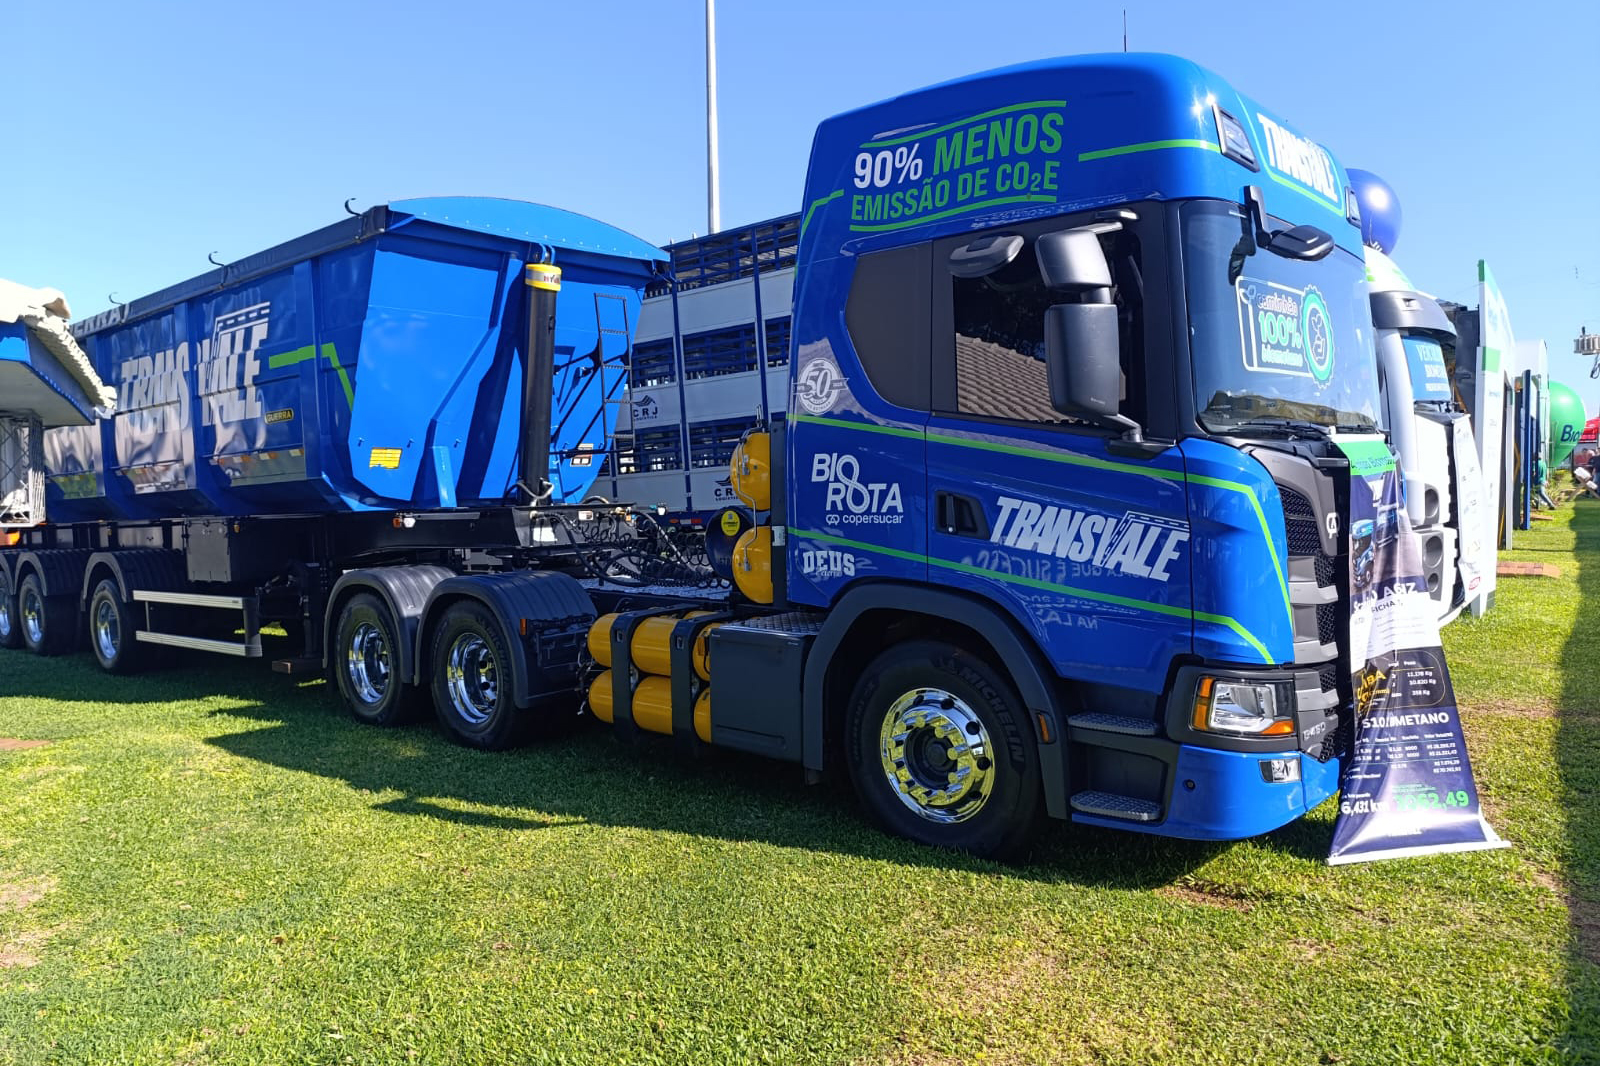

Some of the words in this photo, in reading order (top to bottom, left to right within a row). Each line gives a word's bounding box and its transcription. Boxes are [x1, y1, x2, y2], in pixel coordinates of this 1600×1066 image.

[854, 143, 923, 189] 90%
[932, 112, 1064, 176] MENOS
[851, 177, 950, 221] EMISSÃO
[957, 171, 989, 202] DE
[1259, 311, 1302, 349] 100%
[803, 370, 831, 398] 50
[266, 410, 291, 422] GUERRA
[811, 453, 860, 485] BIO
[826, 482, 904, 514] ROTA
[842, 514, 904, 527] copersucar
[989, 496, 1191, 582] TRANSVALE
[802, 550, 855, 577] DEUS
[961, 665, 1026, 764] MICHELIN
